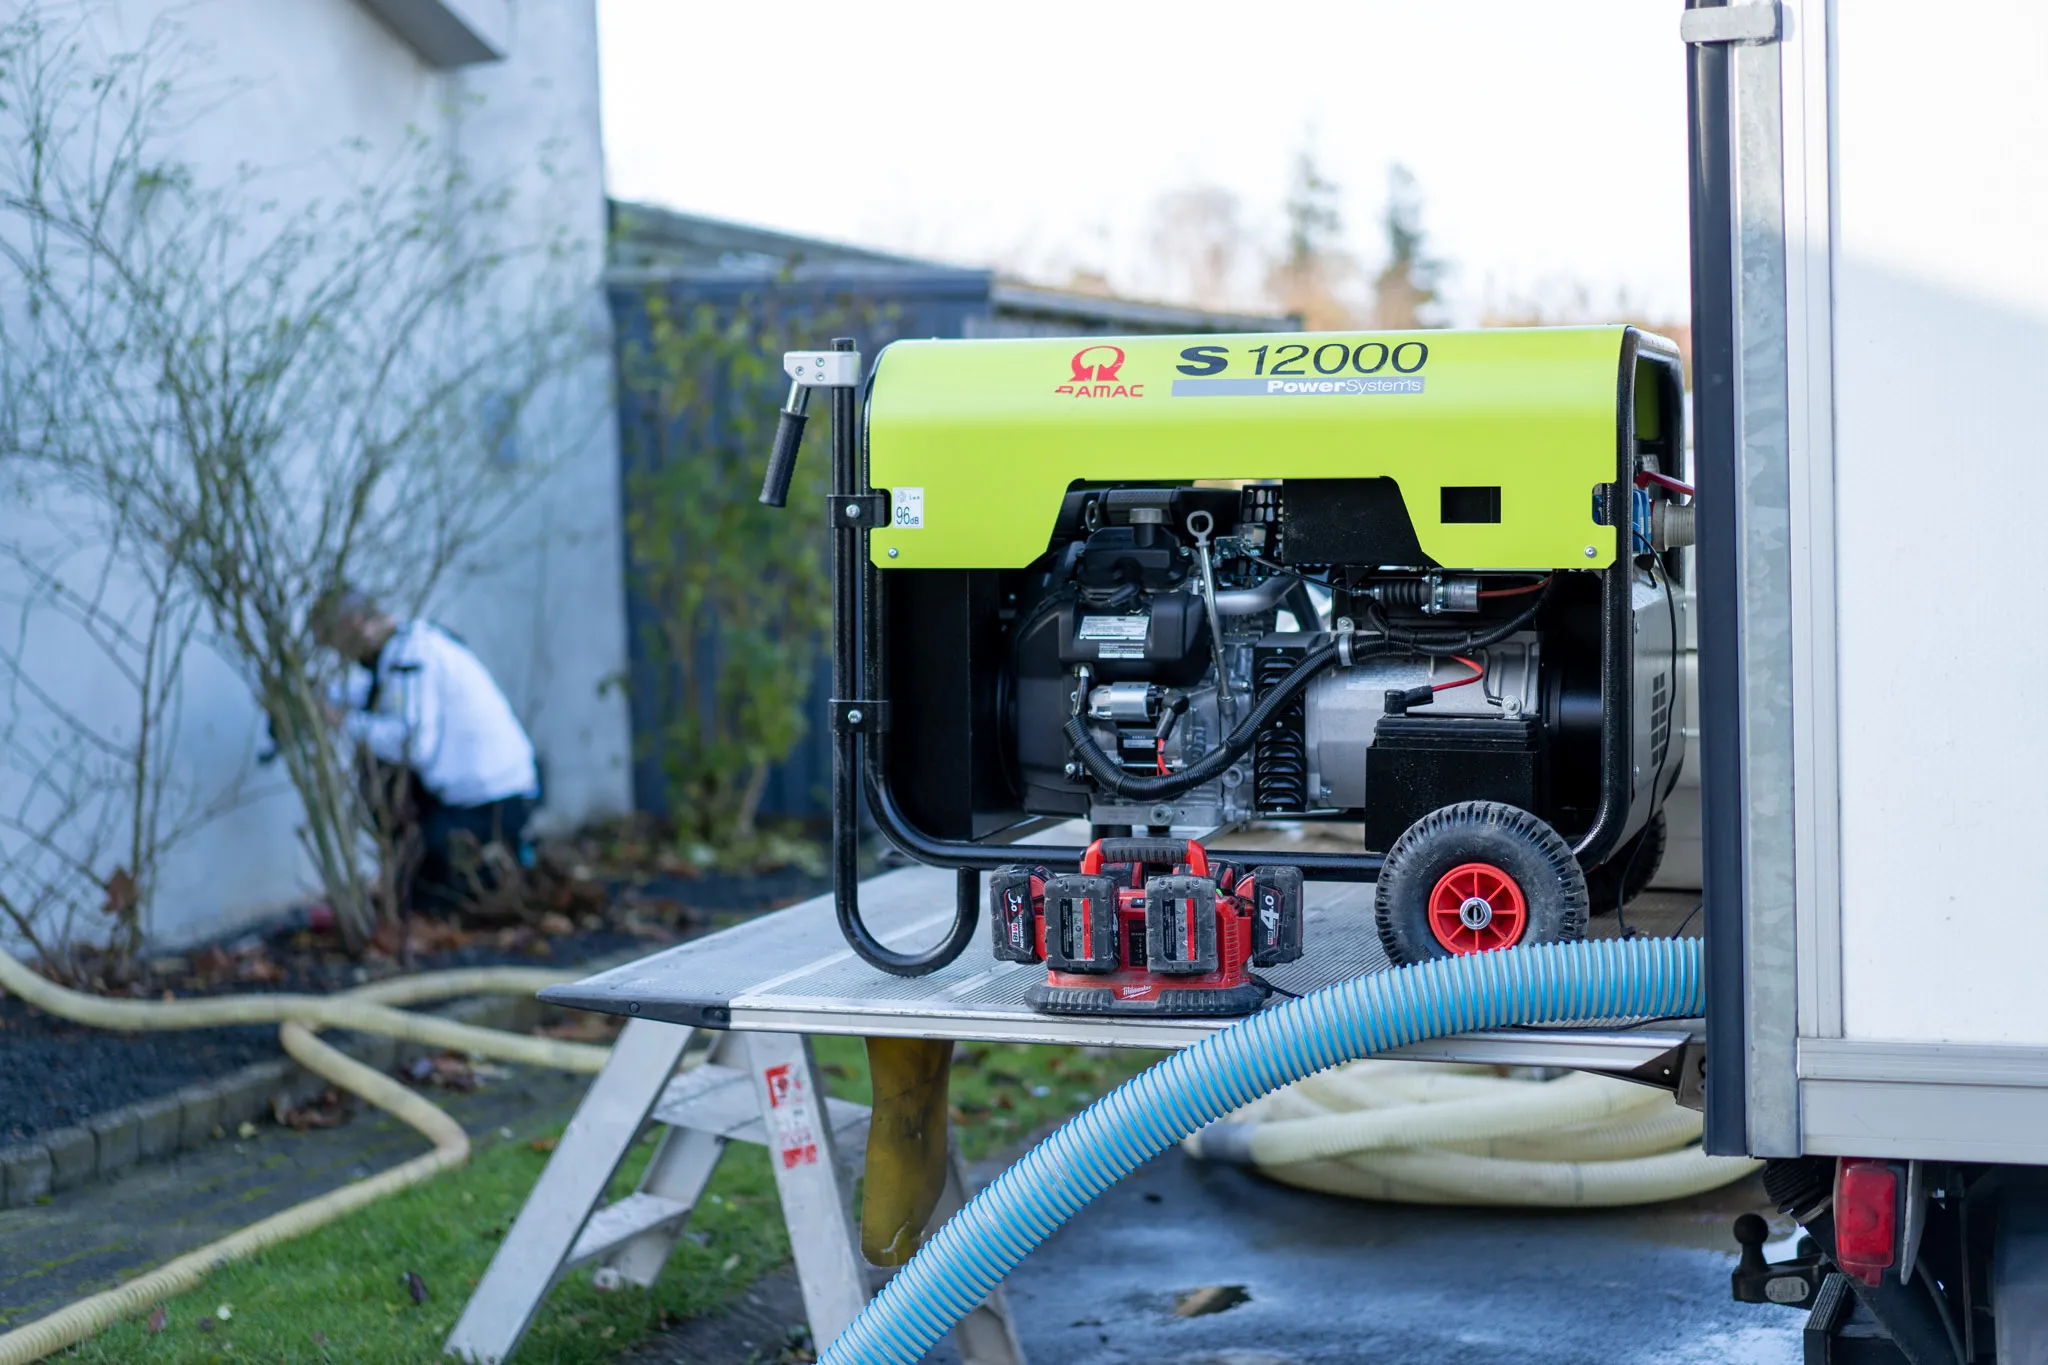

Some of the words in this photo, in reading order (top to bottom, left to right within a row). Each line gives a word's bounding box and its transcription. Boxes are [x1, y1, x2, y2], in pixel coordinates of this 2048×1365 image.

[1176, 345, 1229, 376] S
[1248, 342, 1429, 376] 12000
[1266, 379, 1421, 395] PowerSystems
[1261, 895, 1279, 930] 4.0
